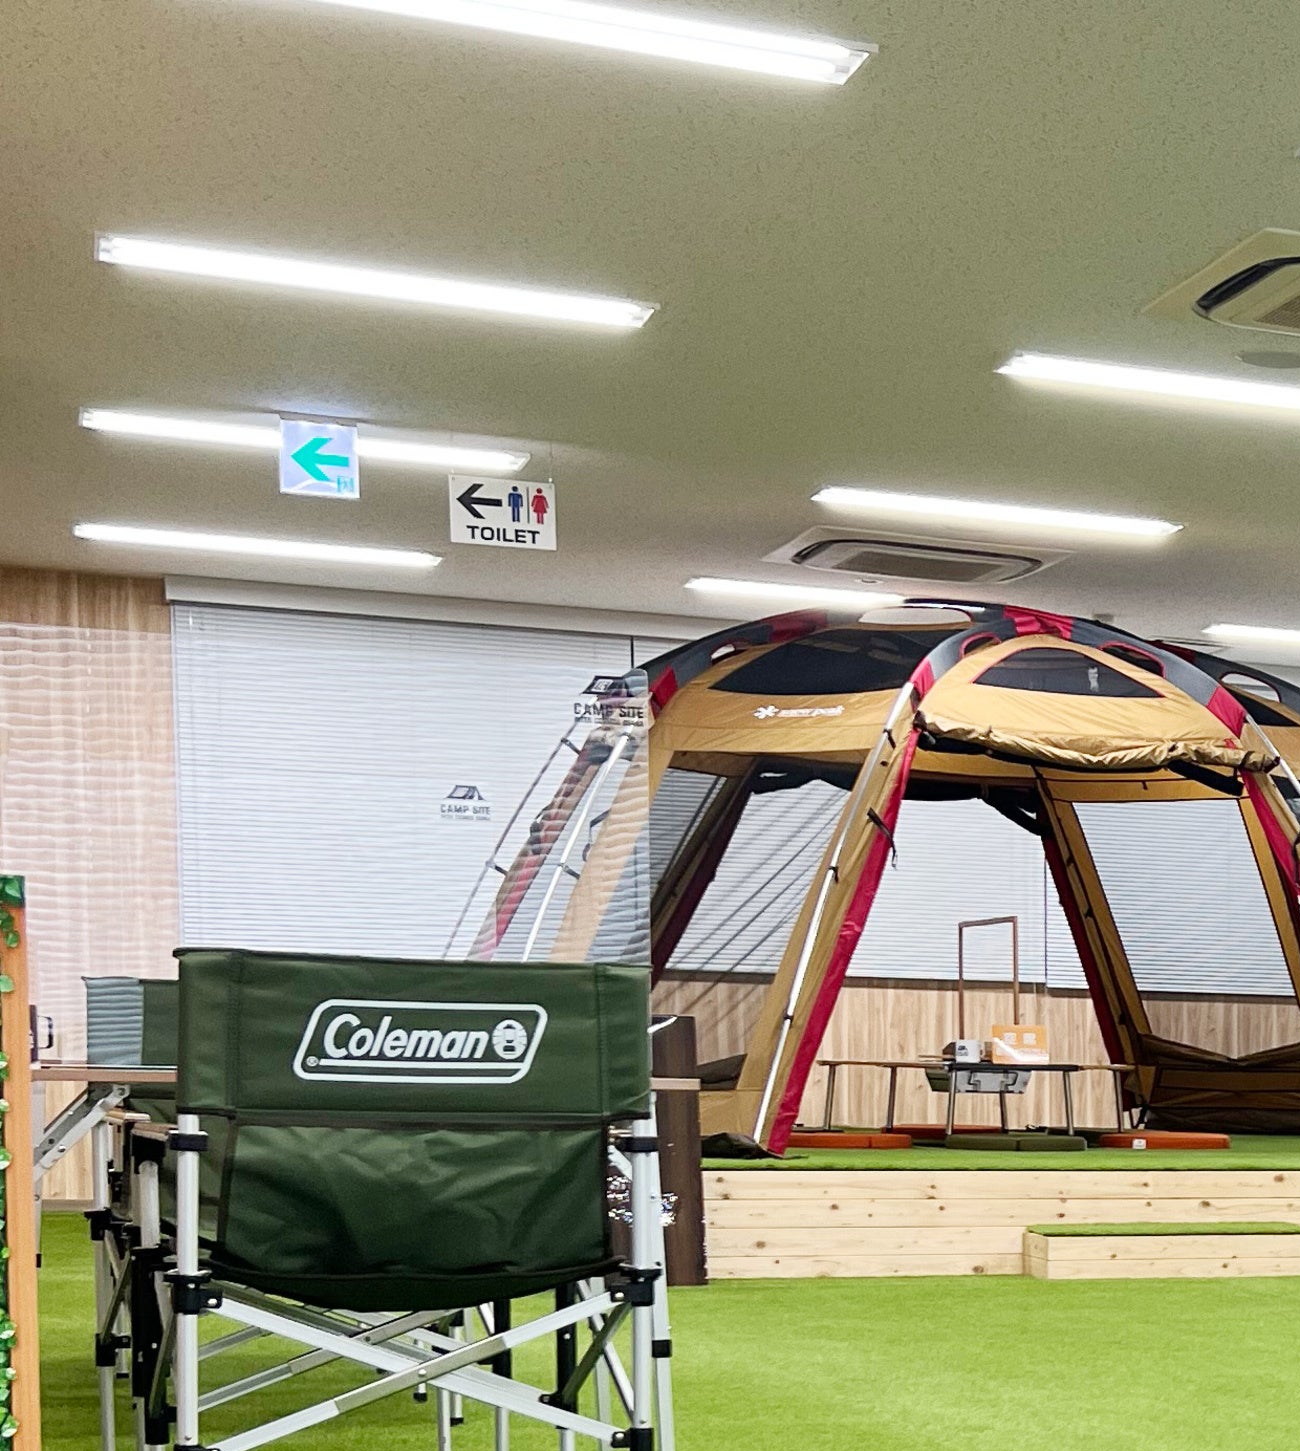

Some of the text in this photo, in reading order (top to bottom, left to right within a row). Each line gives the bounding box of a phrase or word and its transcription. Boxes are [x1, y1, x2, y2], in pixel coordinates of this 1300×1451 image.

[466, 525, 541, 545] TOILET
[619, 705, 645, 719] SITE
[440, 803, 469, 814] CAMP
[323, 1013, 490, 1059] Coleman
